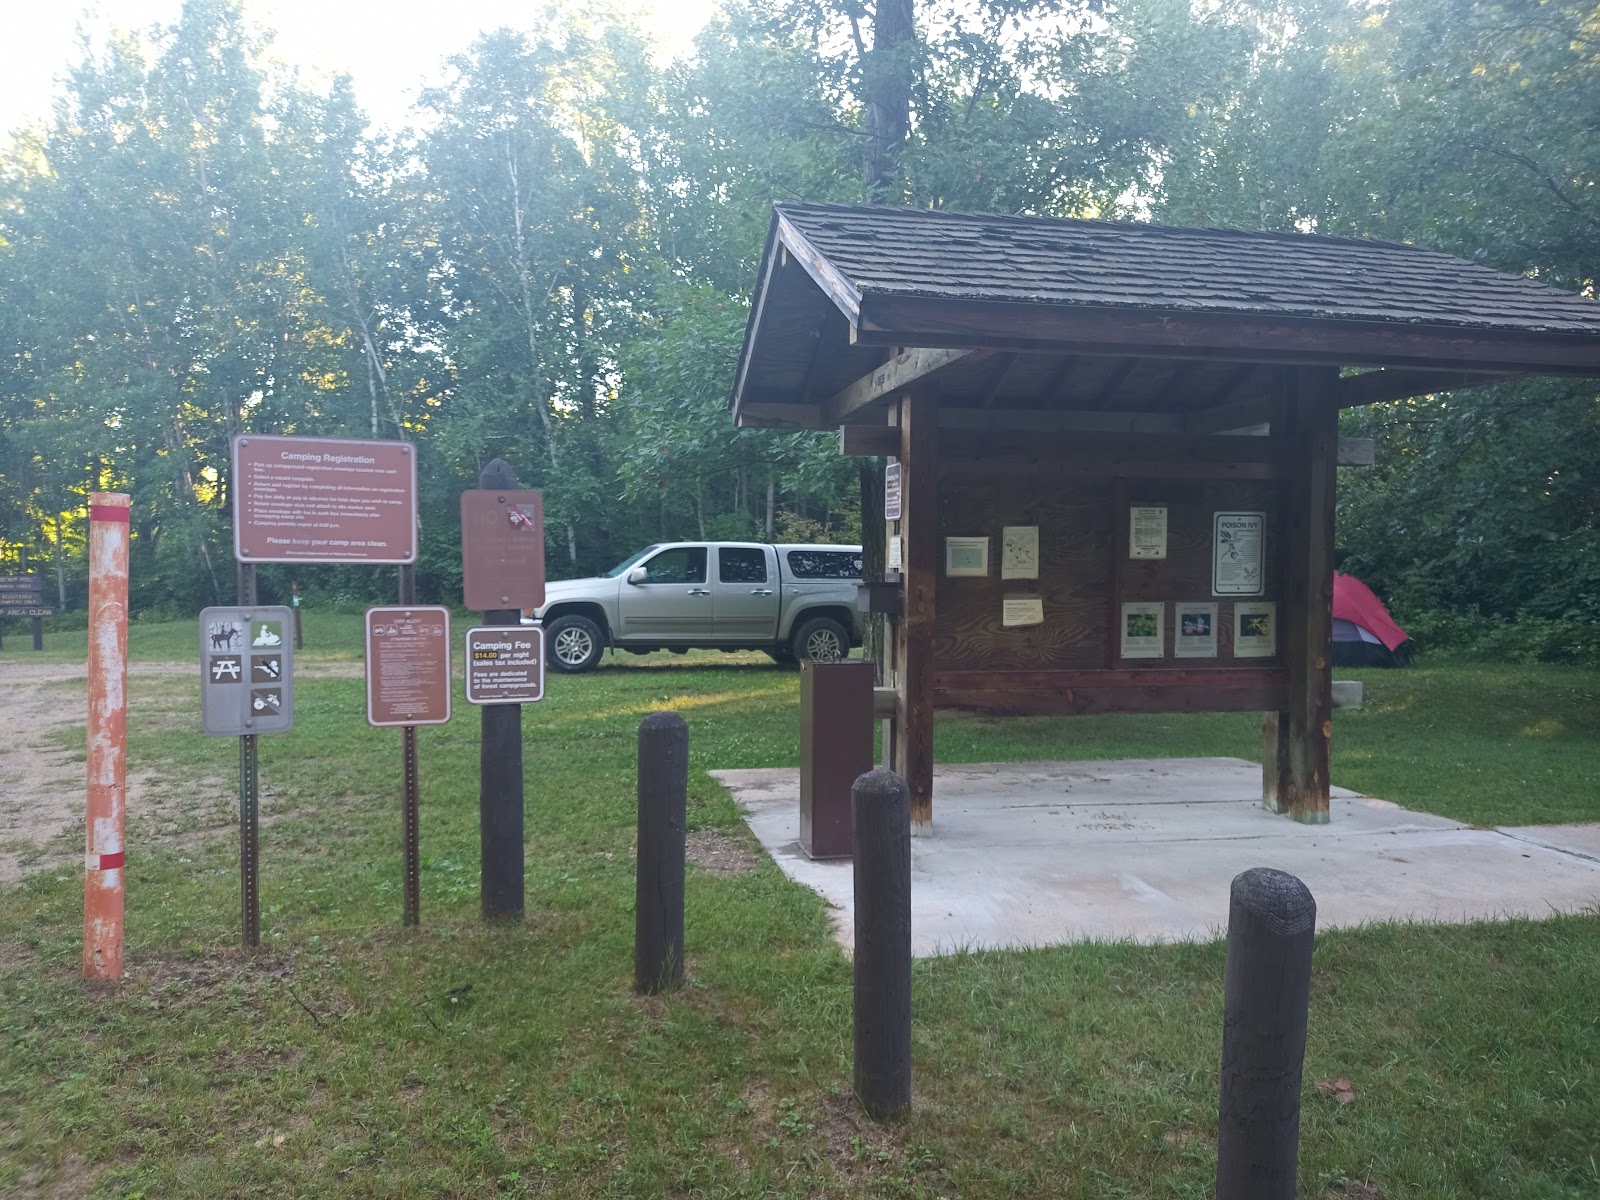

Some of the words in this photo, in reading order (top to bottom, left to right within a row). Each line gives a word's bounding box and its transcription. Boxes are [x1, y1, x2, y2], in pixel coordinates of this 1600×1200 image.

[281, 452, 322, 463] Camping
[323, 454, 375, 464] Registration
[473, 641, 512, 651] Camping
[514, 641, 531, 649] Fee
[513, 651, 530, 659] night
